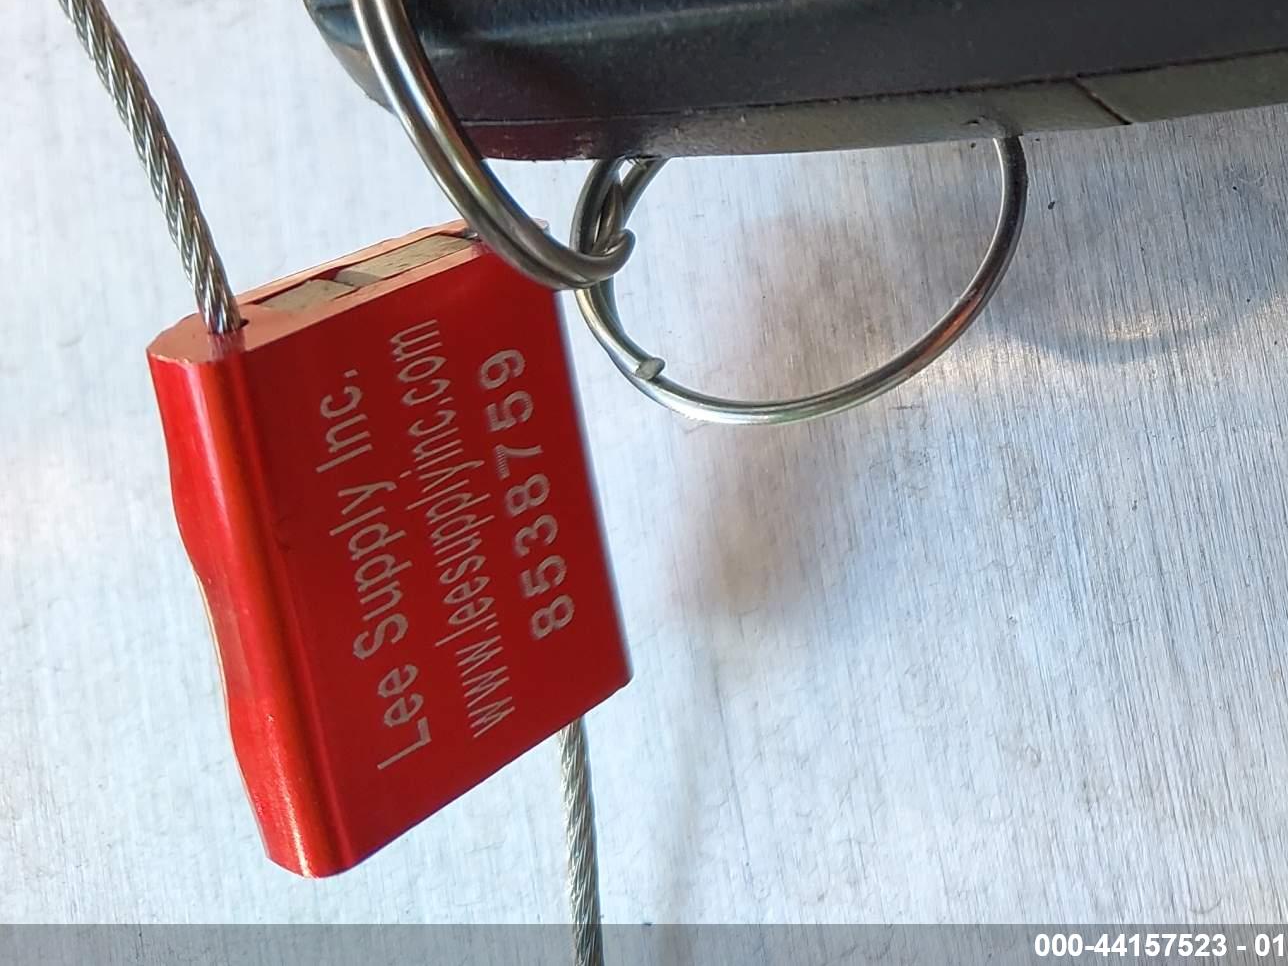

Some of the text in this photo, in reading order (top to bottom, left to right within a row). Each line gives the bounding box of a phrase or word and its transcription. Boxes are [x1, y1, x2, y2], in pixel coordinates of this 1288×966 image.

[316, 369, 432, 770] Lee Supply Inc.
[390, 319, 515, 738] www.leesupplyinc.com
[480, 349, 575, 639] 8538759
